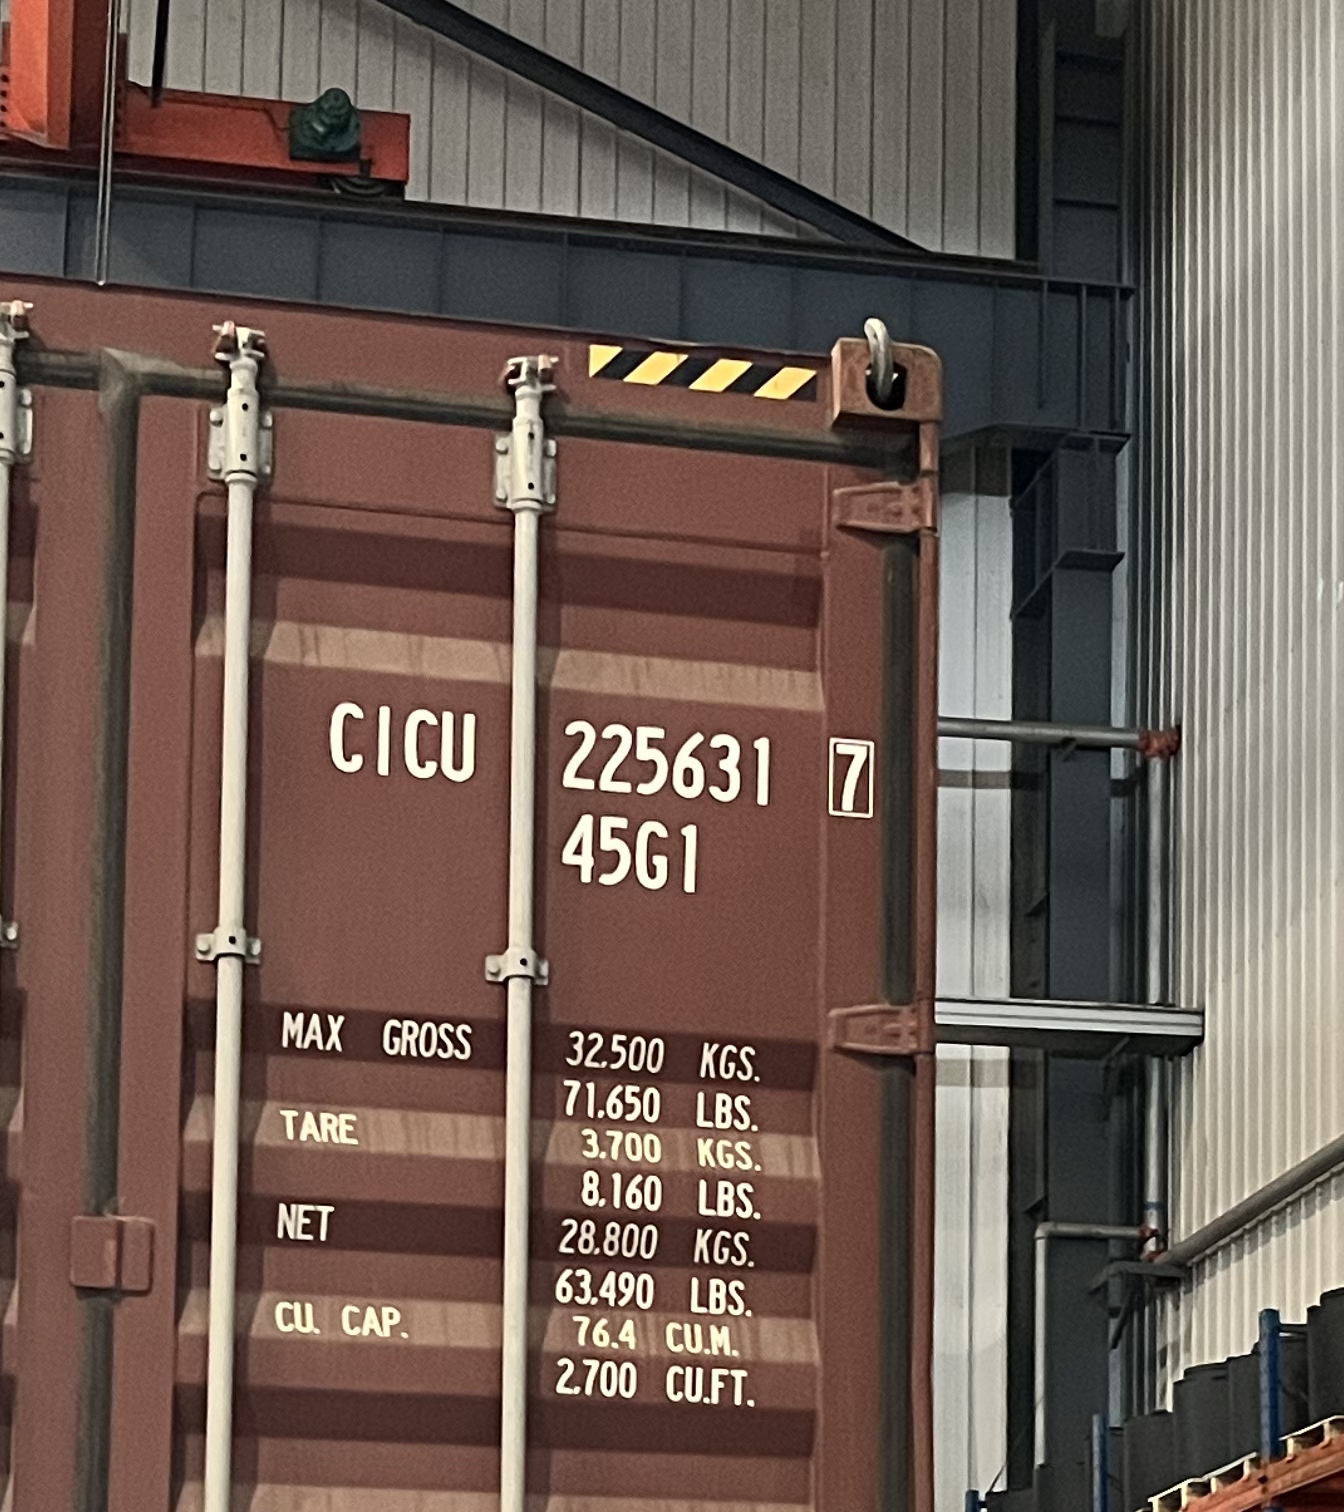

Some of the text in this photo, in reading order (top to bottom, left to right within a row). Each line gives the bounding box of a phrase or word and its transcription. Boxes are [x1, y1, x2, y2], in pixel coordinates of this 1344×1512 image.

[329, 701, 868, 812] CICU 225631 7
[561, 813, 698, 894] 45G1
[281, 1010, 346, 1053] MAX
[382, 1018, 473, 1061] GROSS
[700, 1041, 761, 1083] KGS.
[278, 1109, 360, 1146] TARE
[696, 1137, 762, 1173] KGS.
[696, 1090, 759, 1133] LBS.
[697, 1178, 762, 1221] LBS.
[276, 1201, 336, 1243] NET
[693, 1228, 756, 1268] KGS.
[689, 1276, 753, 1318] LBS.
[274, 1300, 740, 1358] CU. CAP. 76.4 CU.M.
[665, 1364, 756, 1408] CU.FT.
